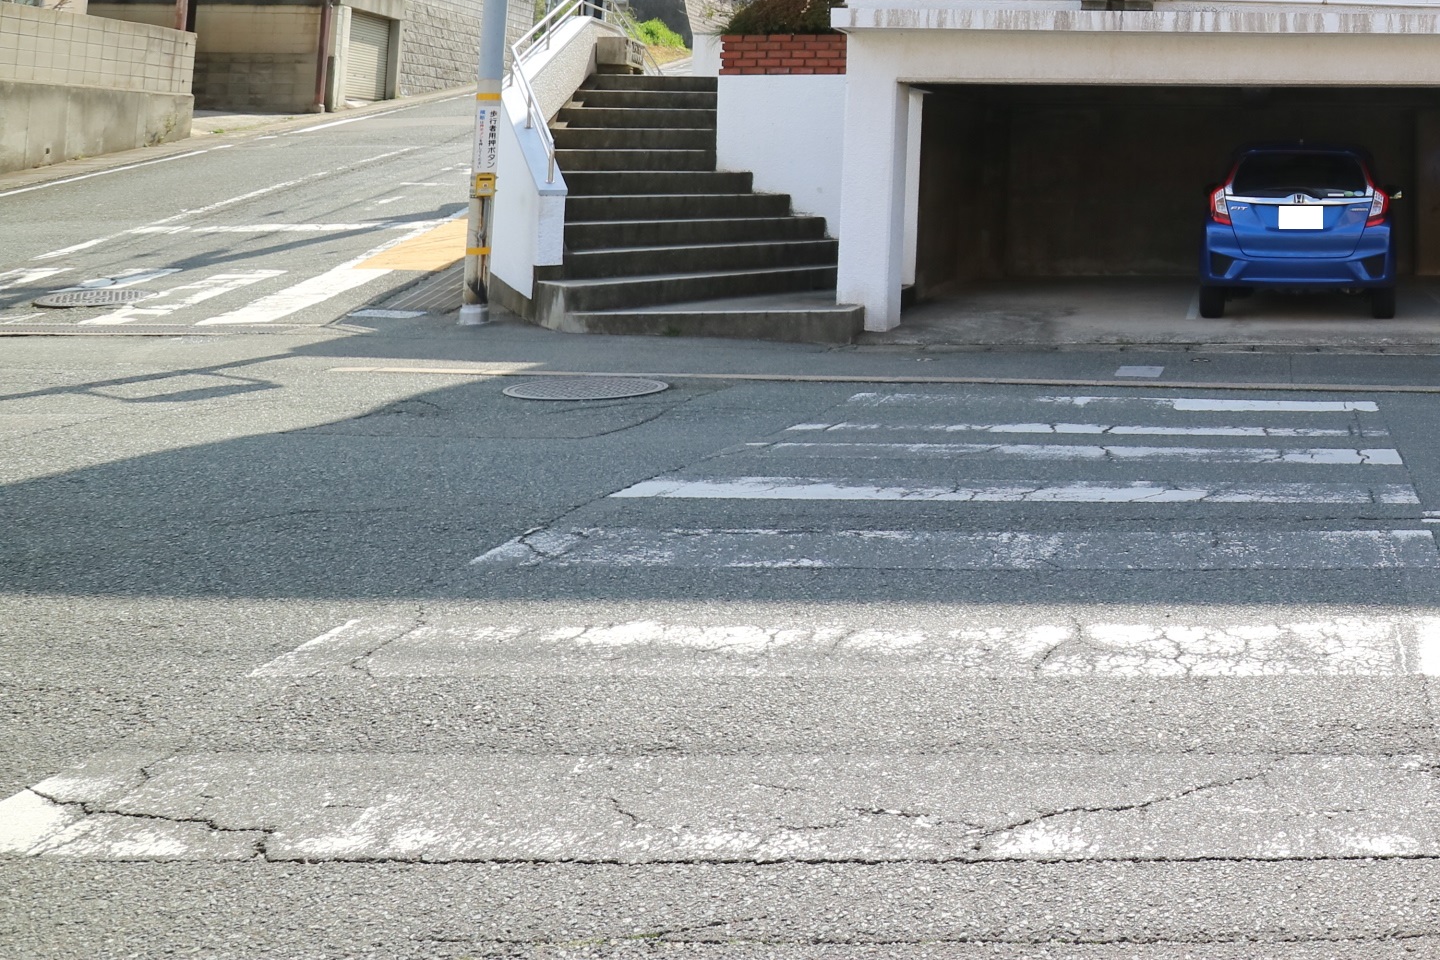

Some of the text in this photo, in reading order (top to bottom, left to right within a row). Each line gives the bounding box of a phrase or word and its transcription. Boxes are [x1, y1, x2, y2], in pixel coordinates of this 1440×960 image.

[487, 110, 498, 169] 歩行者用押ボタン
